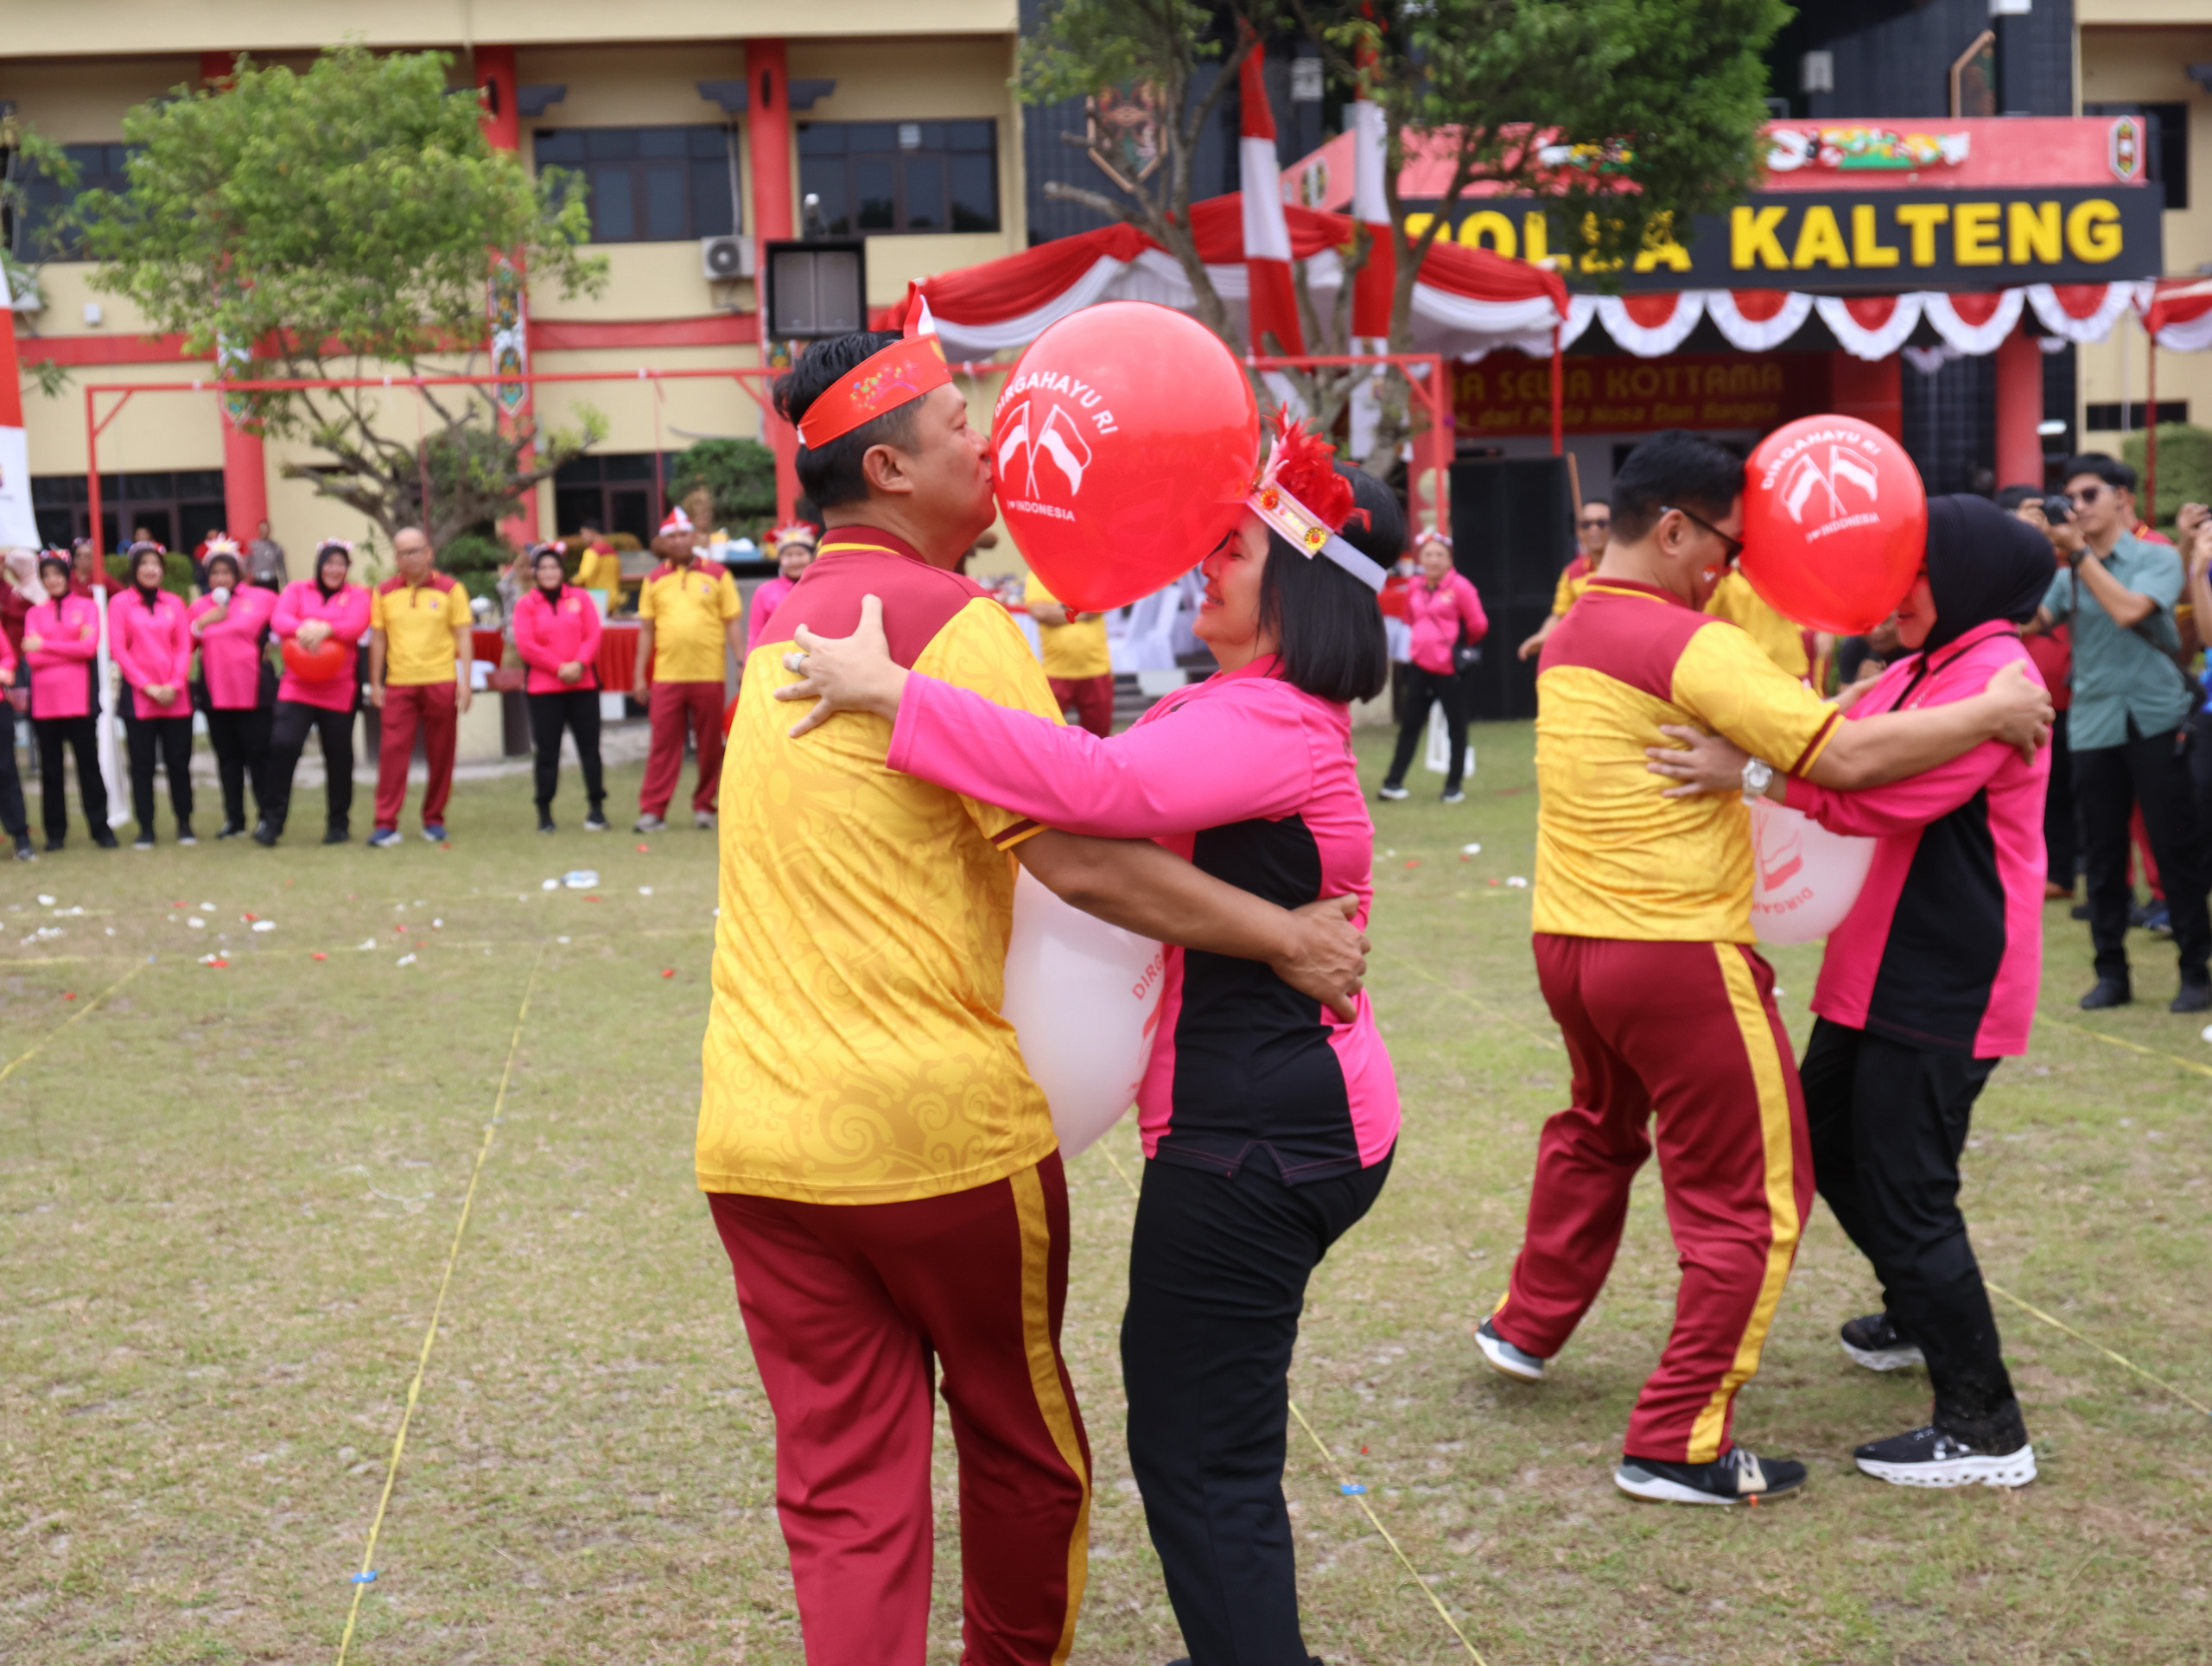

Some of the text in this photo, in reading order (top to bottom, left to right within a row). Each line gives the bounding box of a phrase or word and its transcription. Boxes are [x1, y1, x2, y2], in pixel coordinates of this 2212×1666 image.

[1730, 198, 2124, 270] KALTENG
[995, 371, 1119, 435] DIRGAHAYU RI
[1760, 429, 1860, 490] DIRGAHAYU
[1015, 499, 1076, 522] INDONESIA
